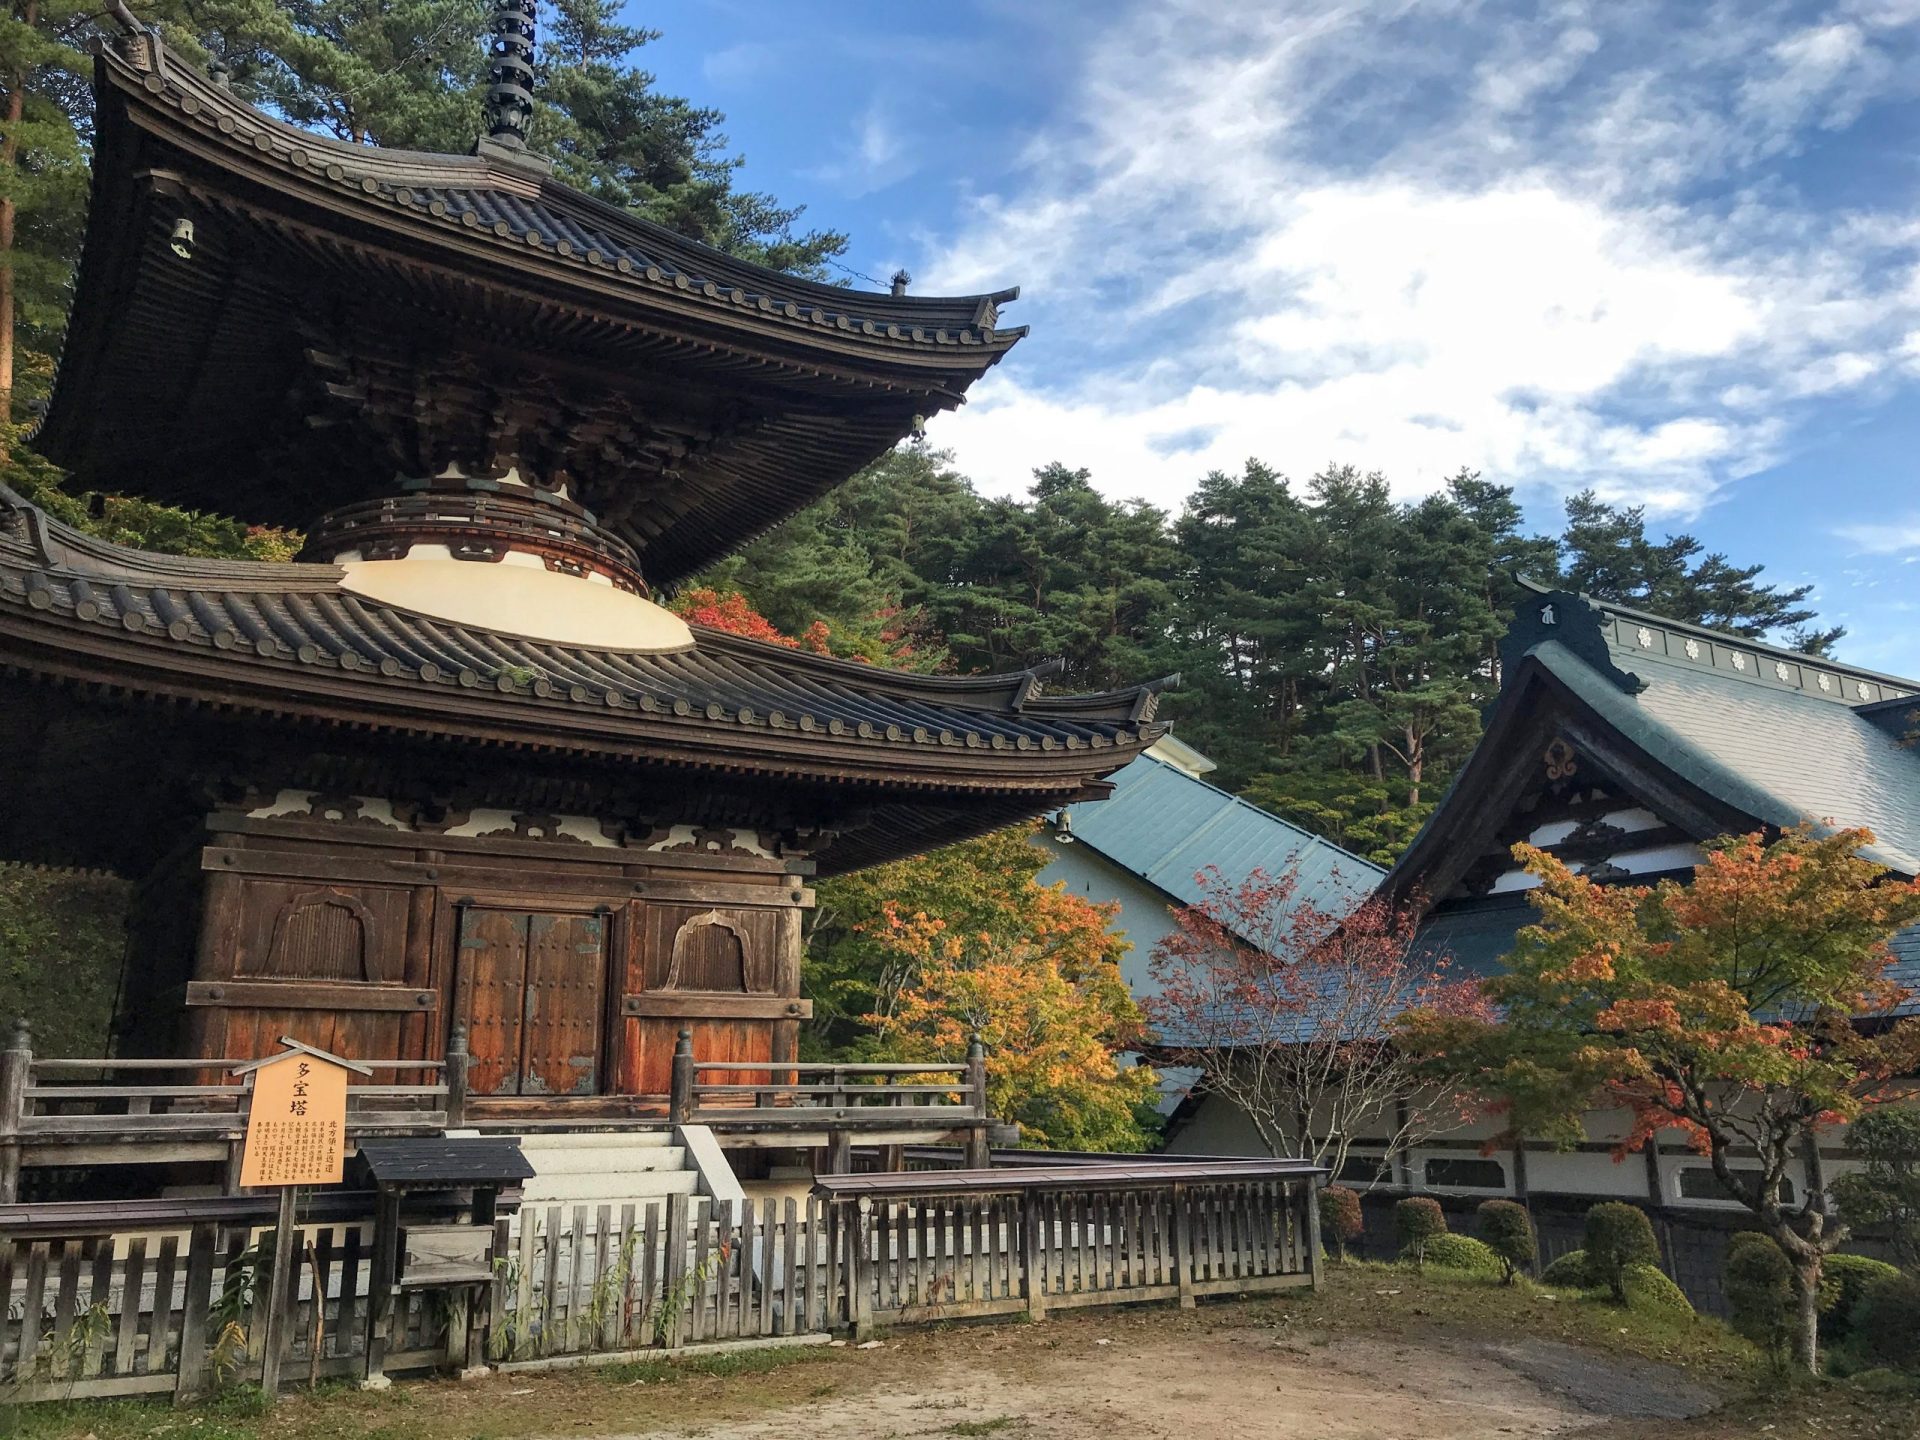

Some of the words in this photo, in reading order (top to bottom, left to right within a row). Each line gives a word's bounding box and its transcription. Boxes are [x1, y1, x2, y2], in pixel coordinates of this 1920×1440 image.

[290, 1062, 311, 1116] 多宝塔
[325, 1121, 337, 1173] 北方領土返還
